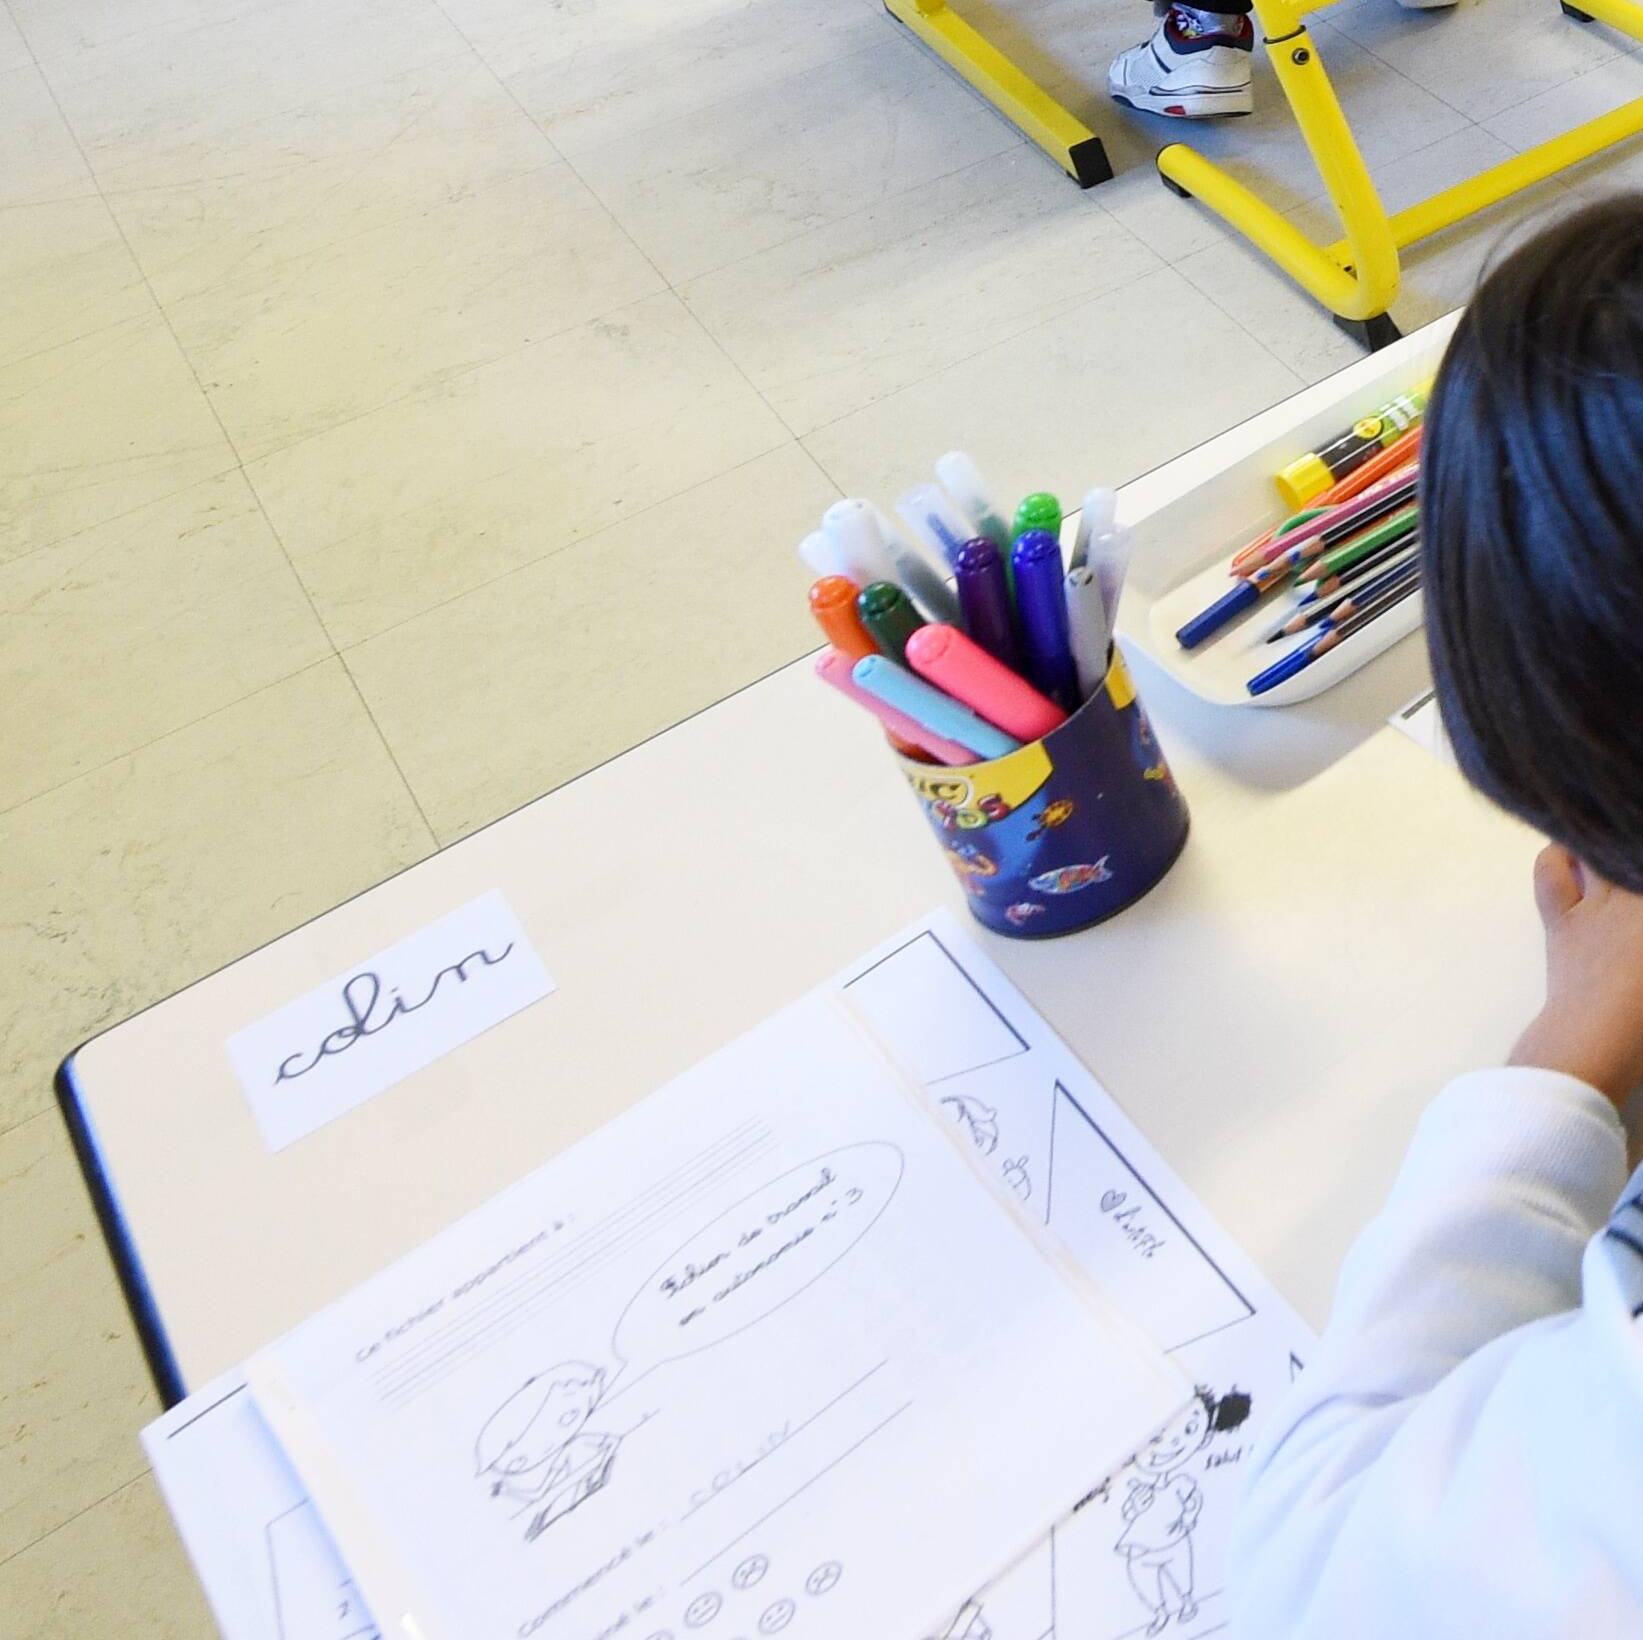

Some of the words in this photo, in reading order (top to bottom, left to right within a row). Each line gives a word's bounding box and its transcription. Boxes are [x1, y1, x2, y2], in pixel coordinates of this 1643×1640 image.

[275, 942, 514, 1085] colin
[738, 1228, 762, 1247] de
[767, 1167, 836, 1225] travail
[356, 1342, 382, 1362] Ce
[385, 1297, 444, 1339] fichier
[453, 1230, 548, 1298] appartient
[679, 1306, 706, 1327] en
[713, 1227, 814, 1302] autonomie
